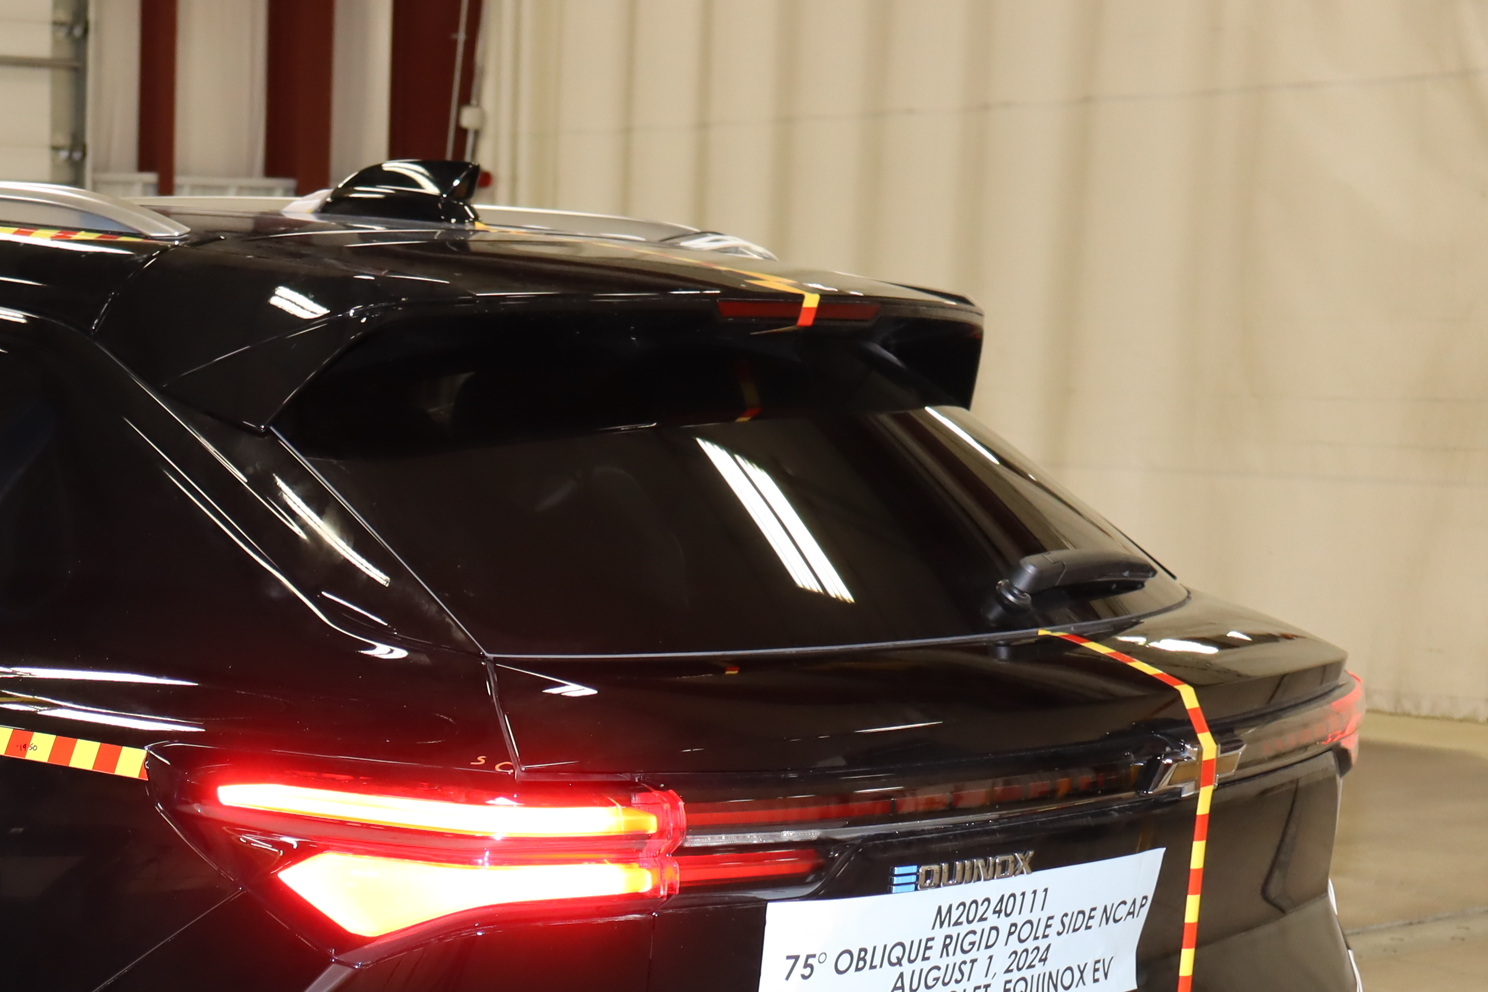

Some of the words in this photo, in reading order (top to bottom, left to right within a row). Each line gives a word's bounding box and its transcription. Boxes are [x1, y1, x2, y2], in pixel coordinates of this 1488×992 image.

[890, 851, 1035, 893] EQUINOX
[931, 887, 1049, 930] M20240111
[785, 952, 828, 981] 75°
[834, 936, 935, 975] OBLIQUE
[939, 925, 1000, 959] RIGID
[1004, 915, 1055, 947] POLE
[1056, 906, 1098, 937] SIDE
[1098, 895, 1149, 928] NCAP
[984, 954, 997, 980] 1,
[1003, 943, 1052, 975] 2024
[1092, 956, 1114, 984] EV
